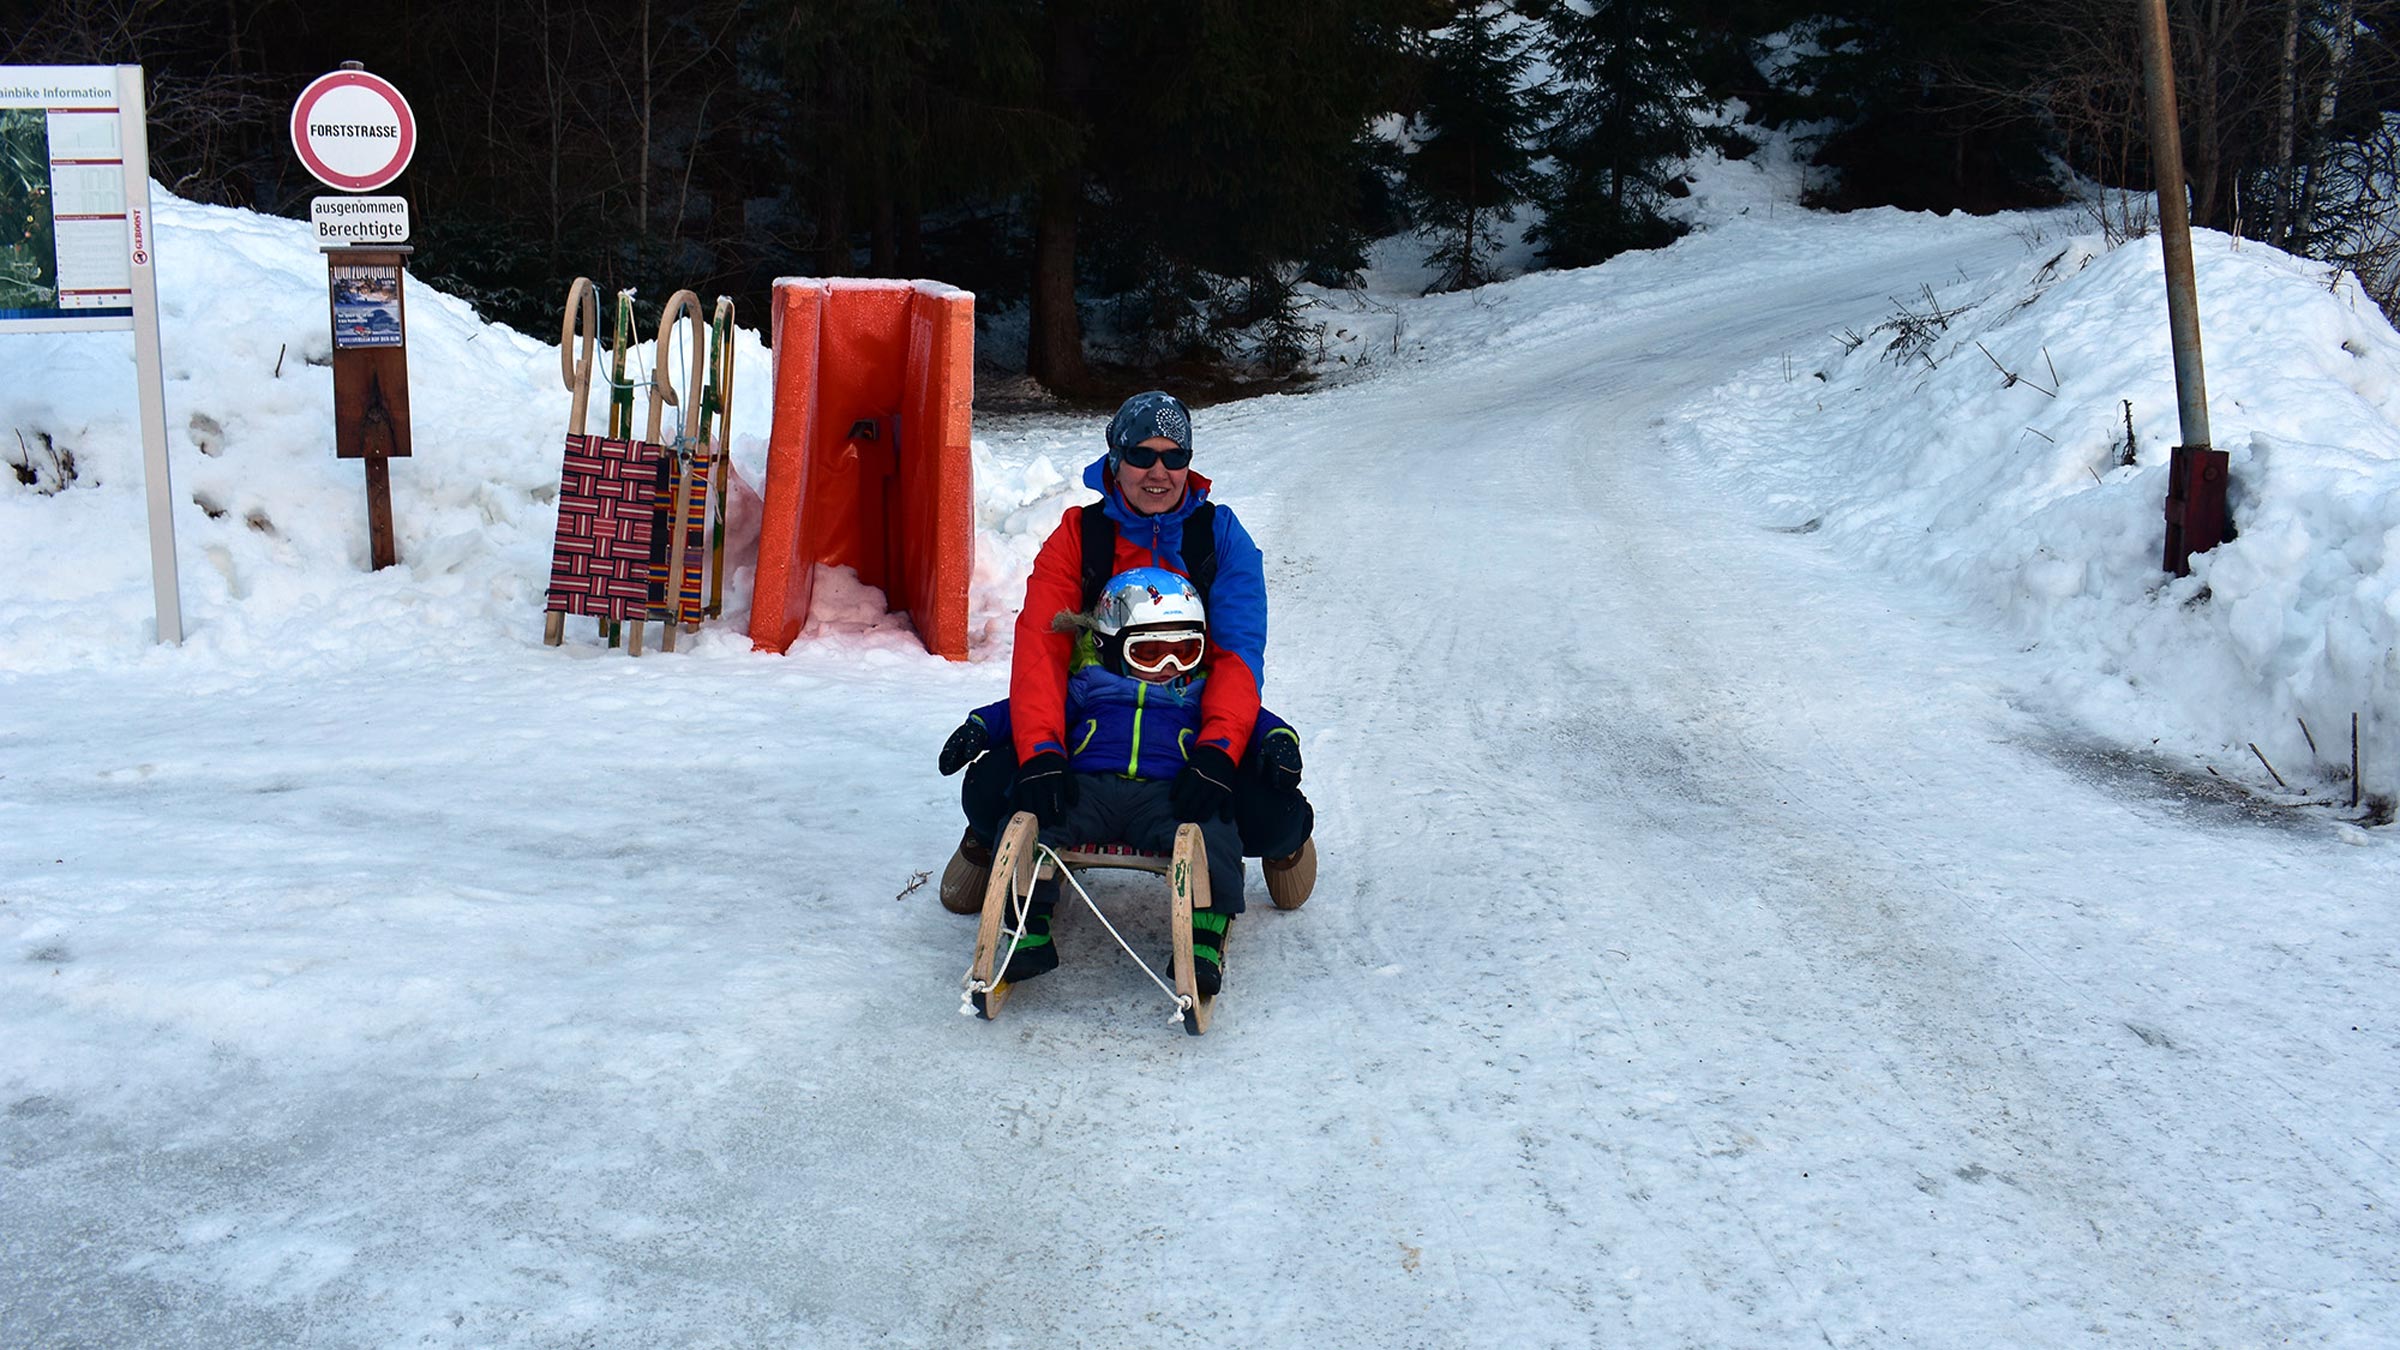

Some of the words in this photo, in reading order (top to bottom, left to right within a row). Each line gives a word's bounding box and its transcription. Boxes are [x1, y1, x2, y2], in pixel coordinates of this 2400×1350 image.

[43, 86, 112, 99] Information
[310, 124, 398, 138] FORSTSTRASSE
[315, 202, 404, 217] ausgenommen
[319, 220, 403, 239] Berechtigte
